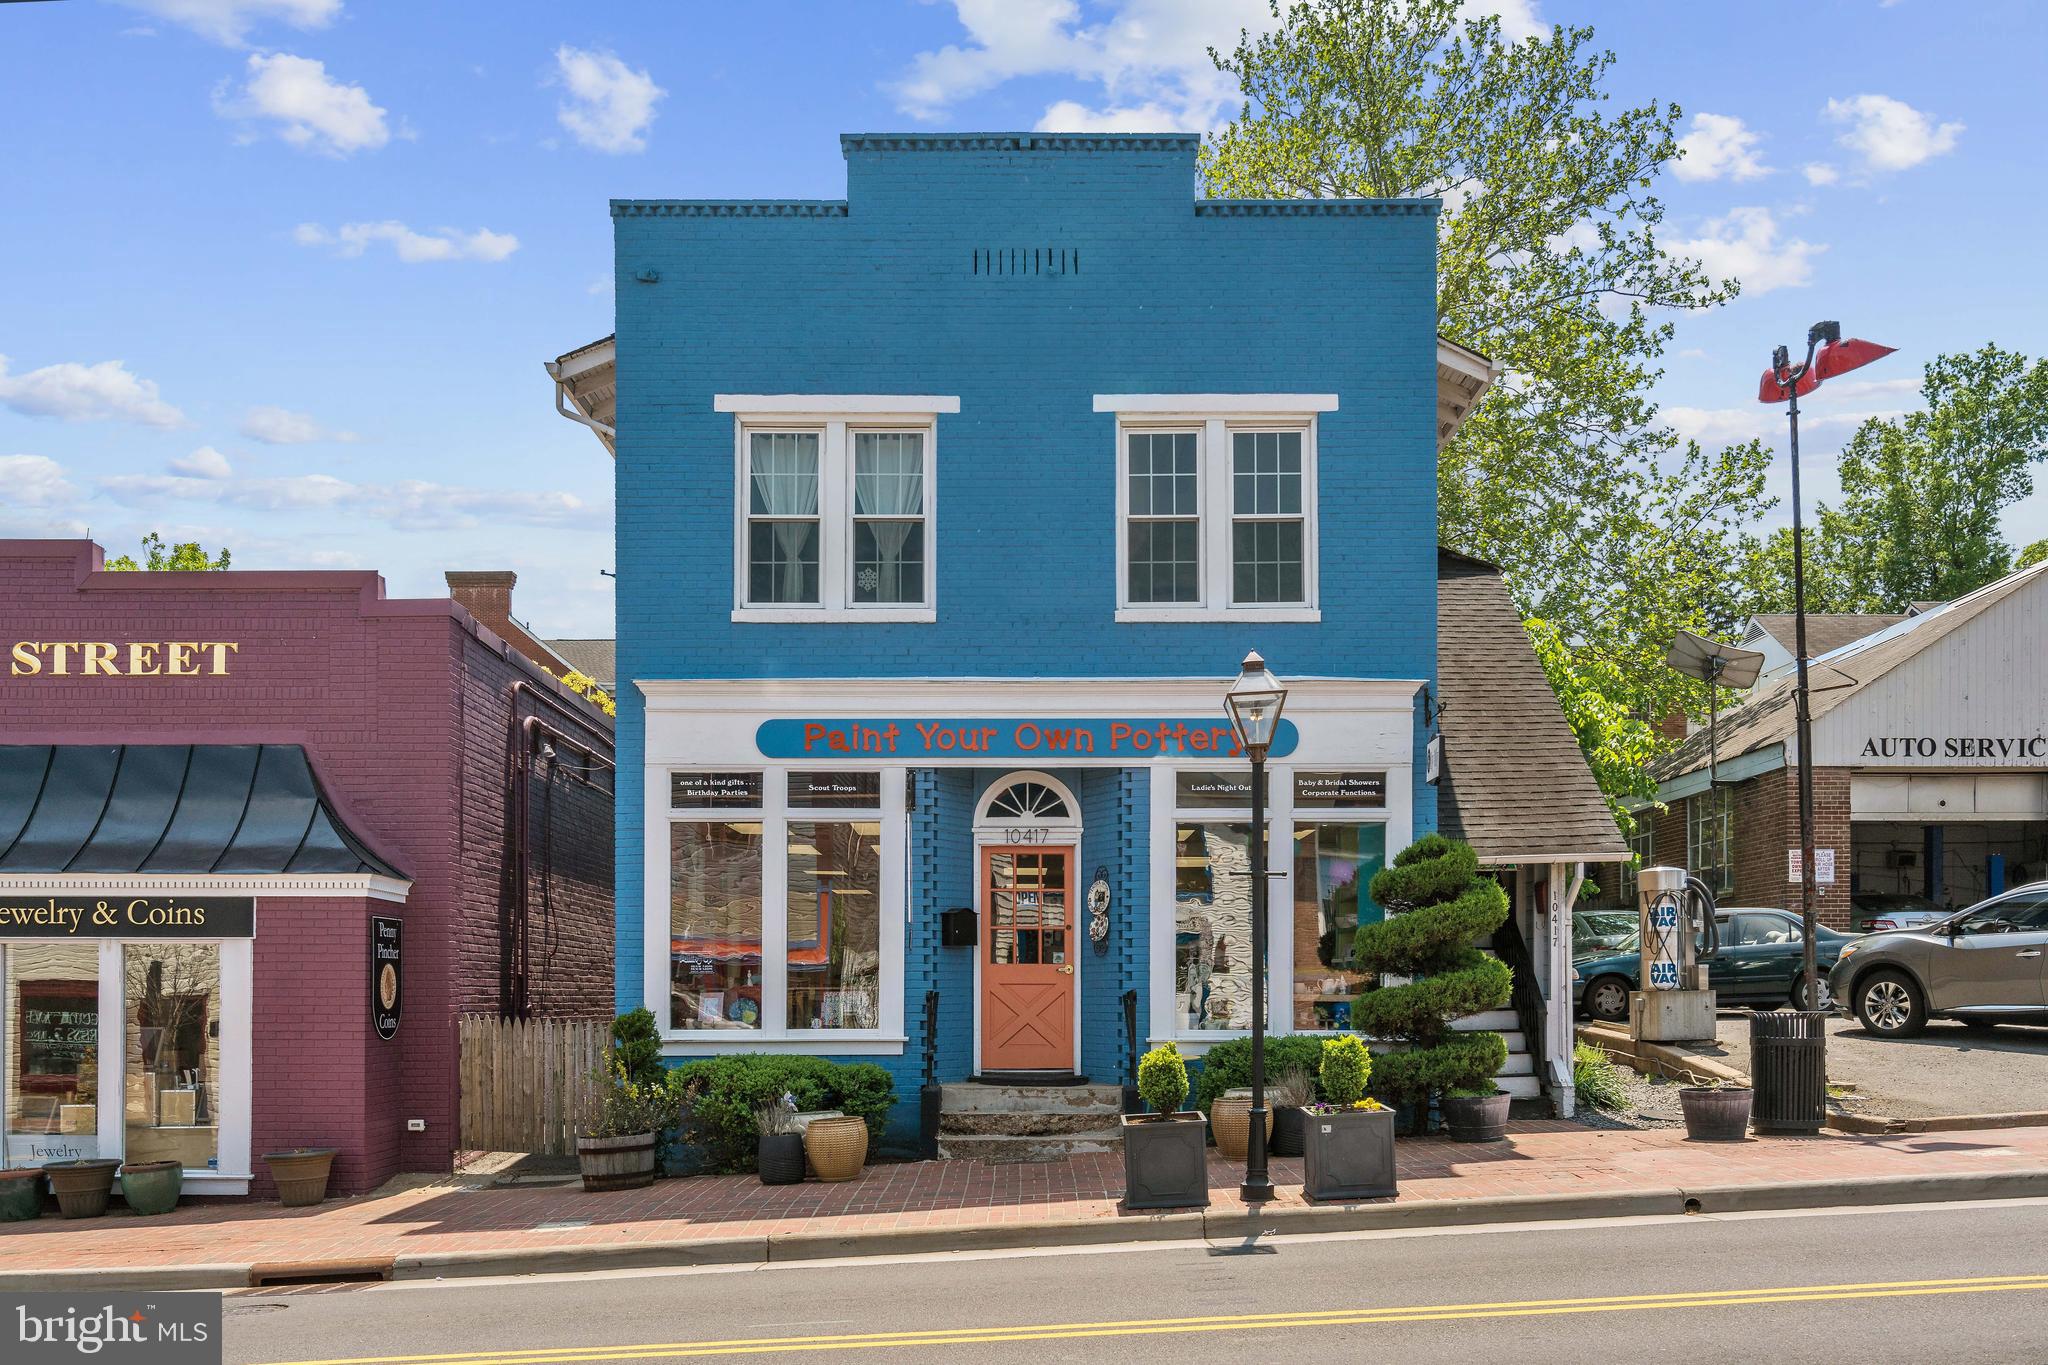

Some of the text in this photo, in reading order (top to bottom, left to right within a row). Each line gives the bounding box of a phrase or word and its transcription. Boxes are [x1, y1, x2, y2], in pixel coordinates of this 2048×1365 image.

[11, 641, 239, 676] STREET
[803, 722, 1247, 756] Paint Your Own Pottery
[1861, 737, 1937, 758] AUTO
[687, 789, 718, 797] Birthday
[832, 784, 856, 792] Troops
[1217, 784, 1236, 792] Night
[1302, 789, 1338, 797] Corporate
[1004, 828, 1049, 844] 10417
[92, 900, 118, 925] &
[127, 898, 205, 926] Coins
[379, 922, 397, 942] Penny
[377, 944, 399, 959] Pincher
[1651, 963, 1676, 974] AIR
[1651, 974, 1677, 984] VAC
[379, 1014, 397, 1028] Coins
[30, 1144, 82, 1161] Jewelry
